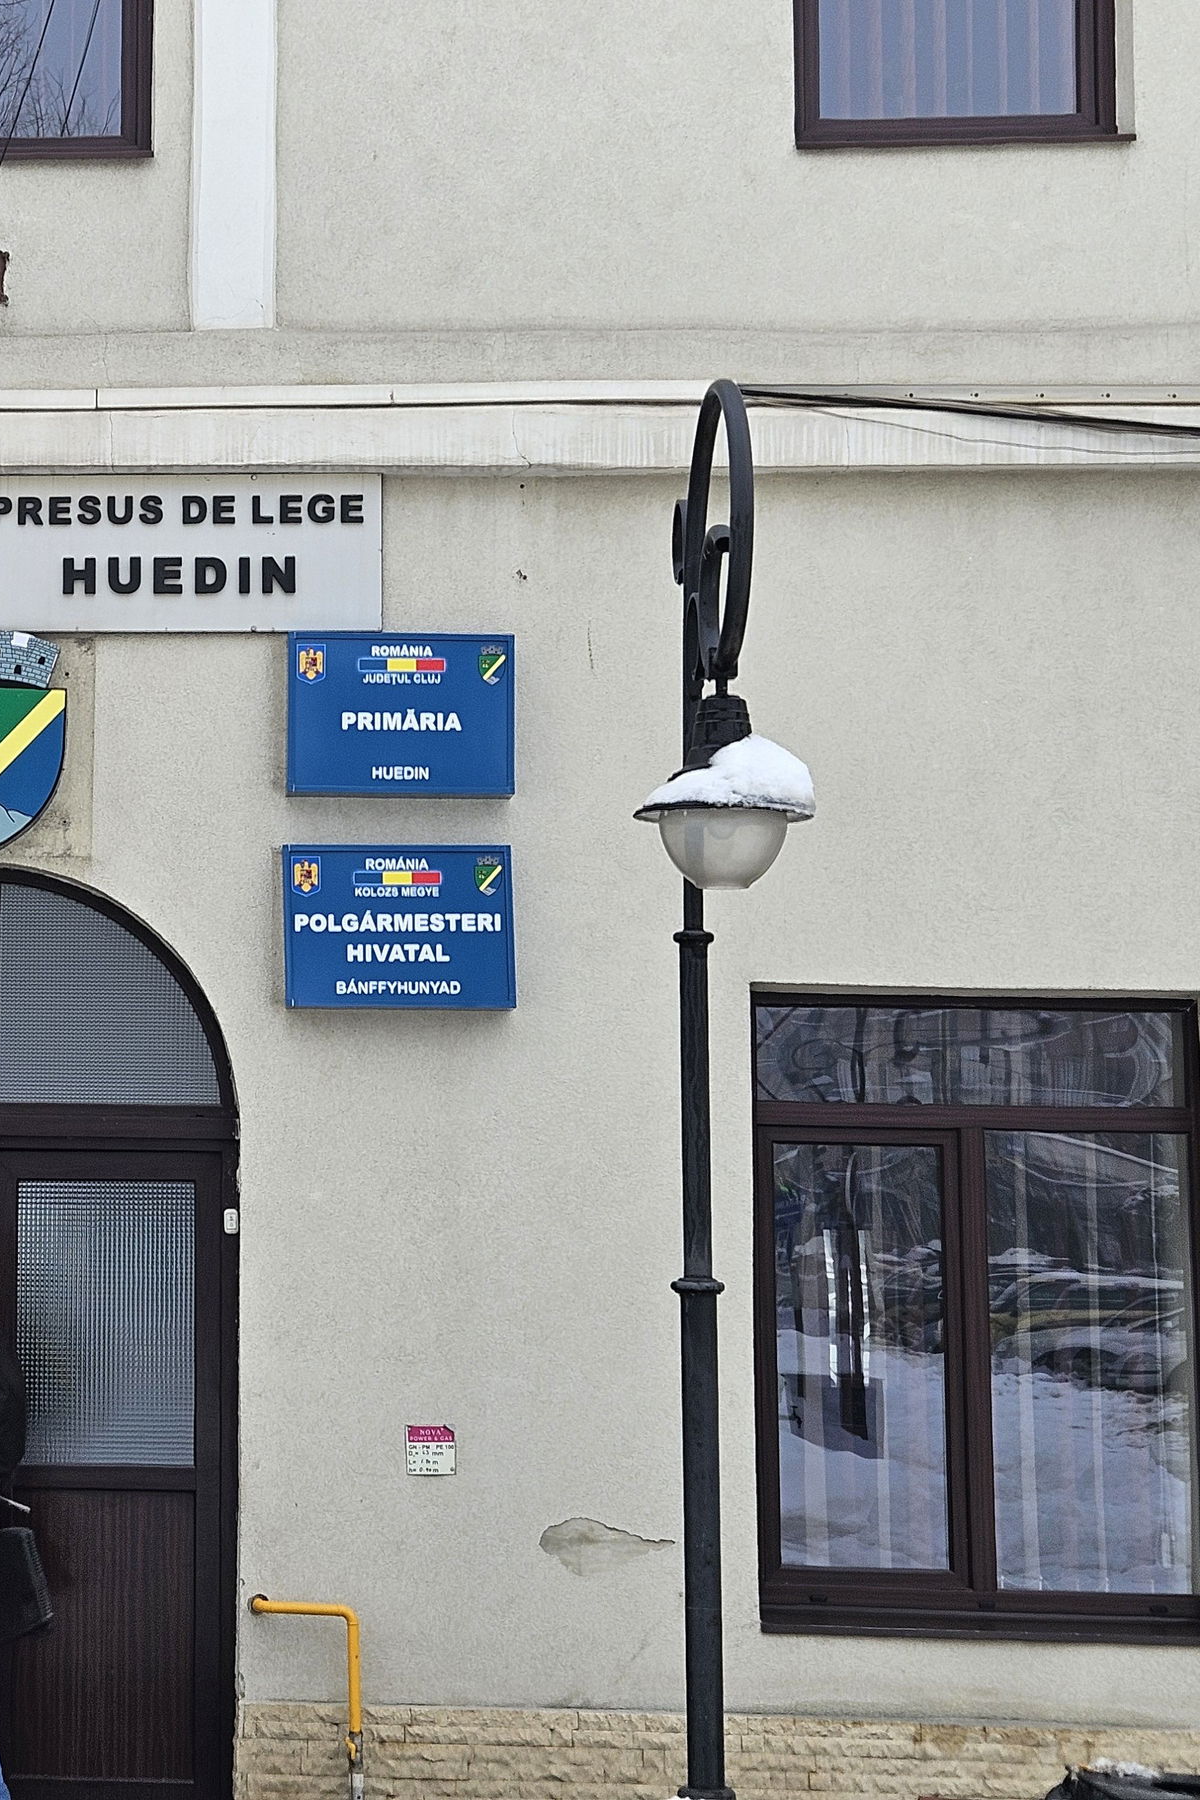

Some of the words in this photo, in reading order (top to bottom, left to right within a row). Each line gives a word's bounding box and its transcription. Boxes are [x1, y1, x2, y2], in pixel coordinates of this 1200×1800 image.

[182, 495, 236, 525] DE
[251, 494, 364, 524] LEGE
[62, 555, 296, 595] HUEDIN
[371, 644, 433, 657] ROMÂNIA
[413, 673, 442, 685] CLUJ
[341, 708, 463, 732] PRIMĂRIA
[371, 765, 430, 781] HUEDIN
[365, 856, 429, 871] ROMÁNIA
[354, 886, 399, 898] KOLOZS
[401, 886, 440, 898] MEGYE
[294, 910, 502, 933] POLGÁRMESTERI
[346, 943, 451, 963] HIVATAL
[335, 978, 461, 995] BÁNFFYHUNYAD
